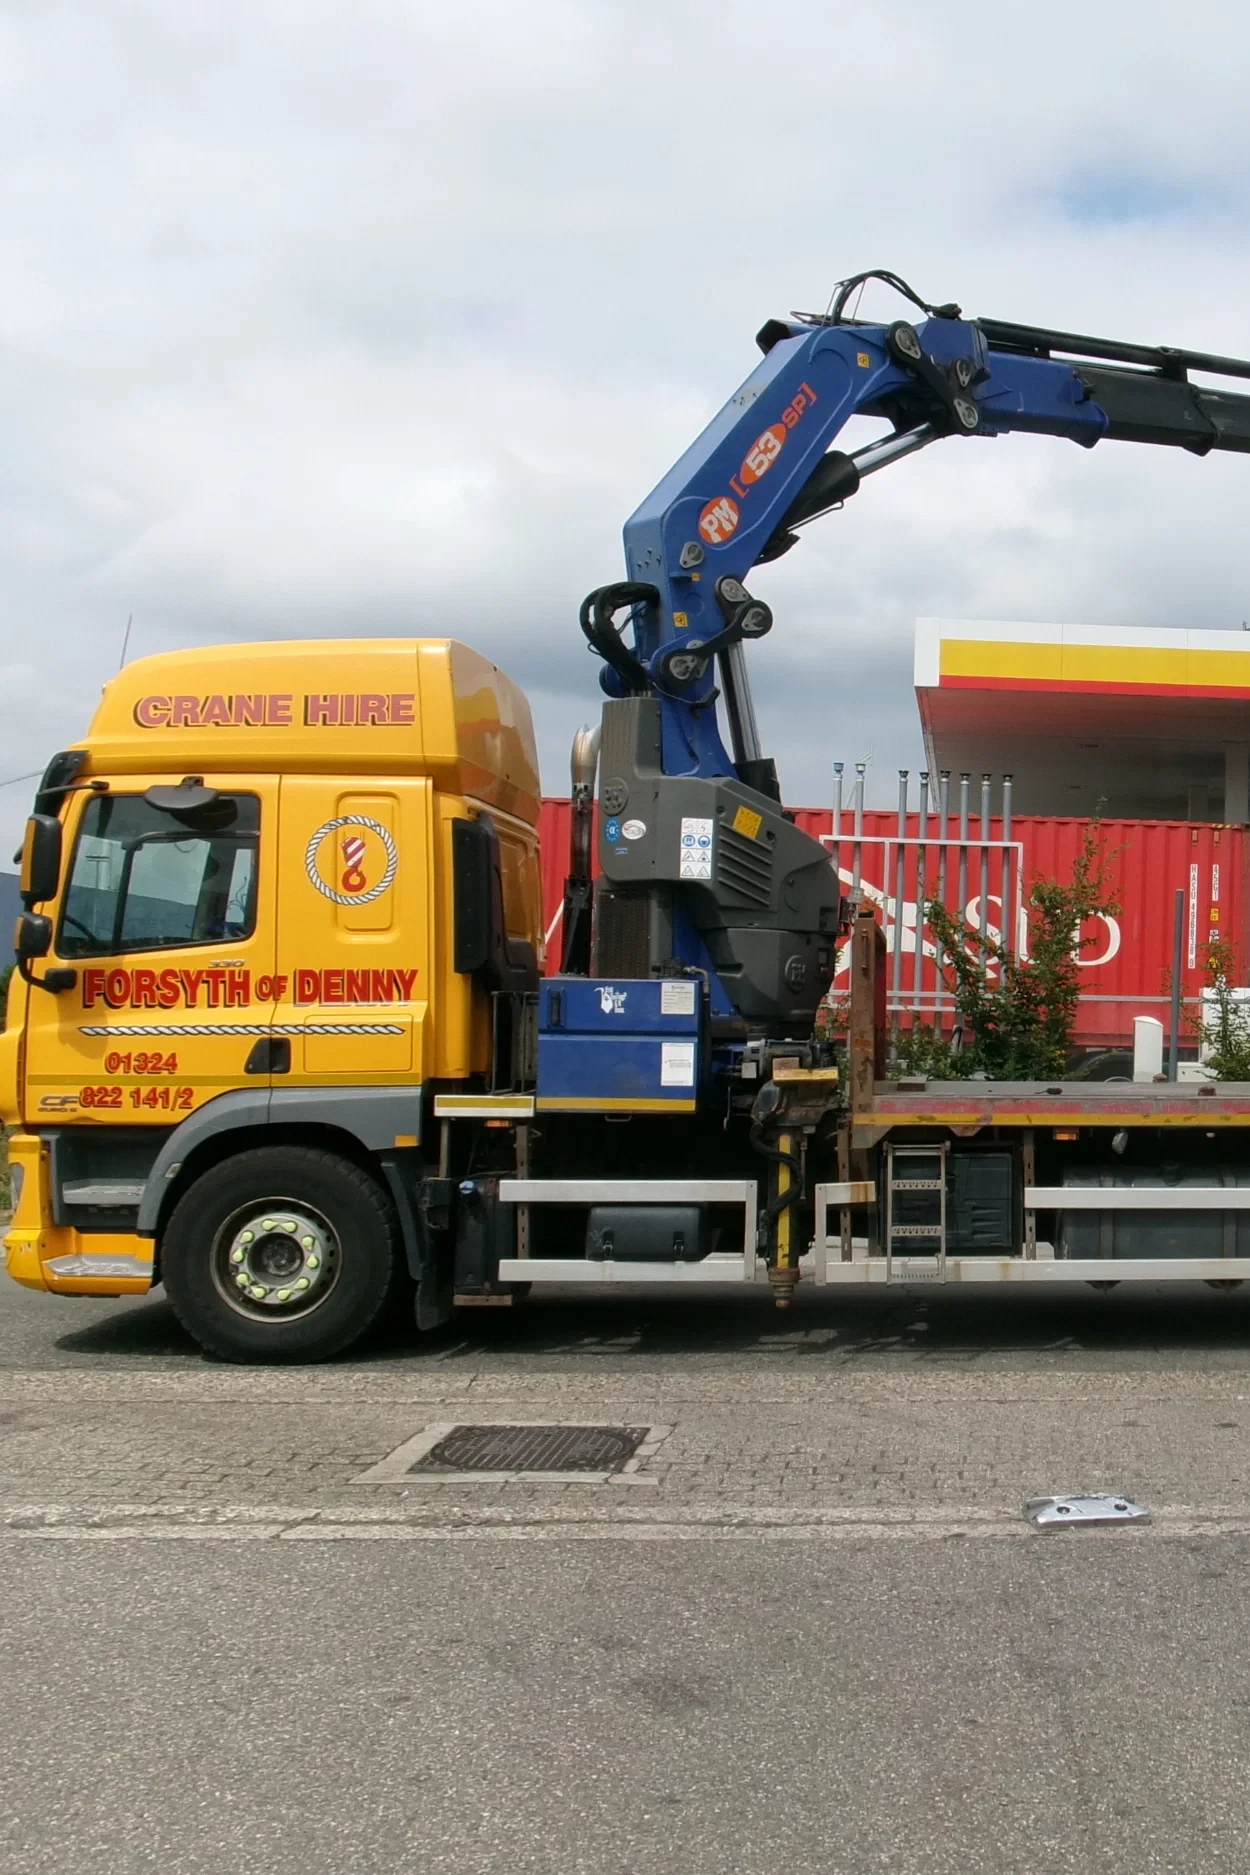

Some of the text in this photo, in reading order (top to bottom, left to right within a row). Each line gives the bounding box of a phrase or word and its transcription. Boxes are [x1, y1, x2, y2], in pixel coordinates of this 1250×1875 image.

[745, 431, 783, 477] 53
[701, 498, 739, 544] PM
[134, 693, 416, 728] CRANE HIRE
[207, 959, 245, 969] 330
[82, 968, 419, 1008] FORSYTH OF DENNY
[105, 1052, 178, 1074] 01324
[40, 1094, 80, 1106] CF
[80, 1086, 194, 1111] 822 141/2
